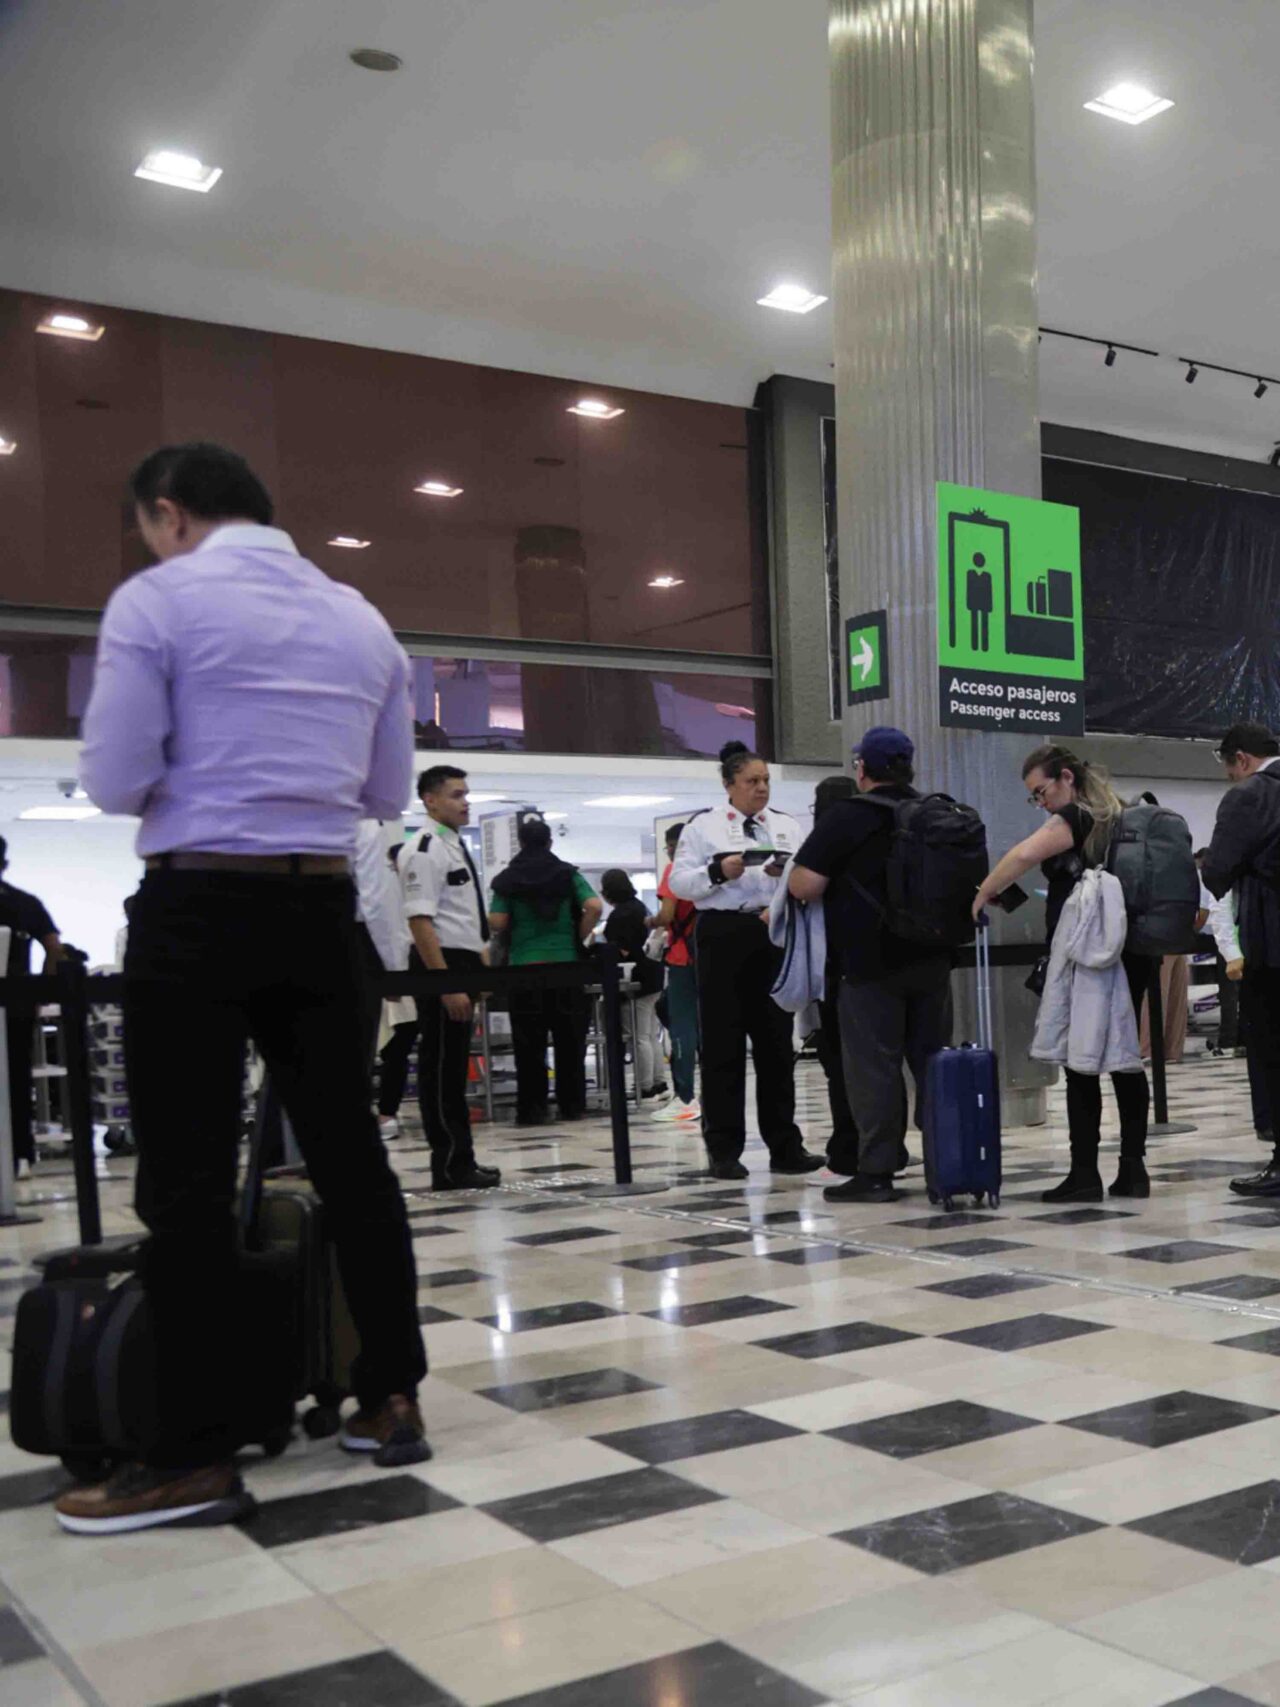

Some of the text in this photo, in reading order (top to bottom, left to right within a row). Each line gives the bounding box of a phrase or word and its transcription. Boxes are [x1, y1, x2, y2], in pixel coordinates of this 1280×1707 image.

[949, 677, 1077, 705] Acceso pasajeros
[950, 701, 1061, 722] Passenger access
